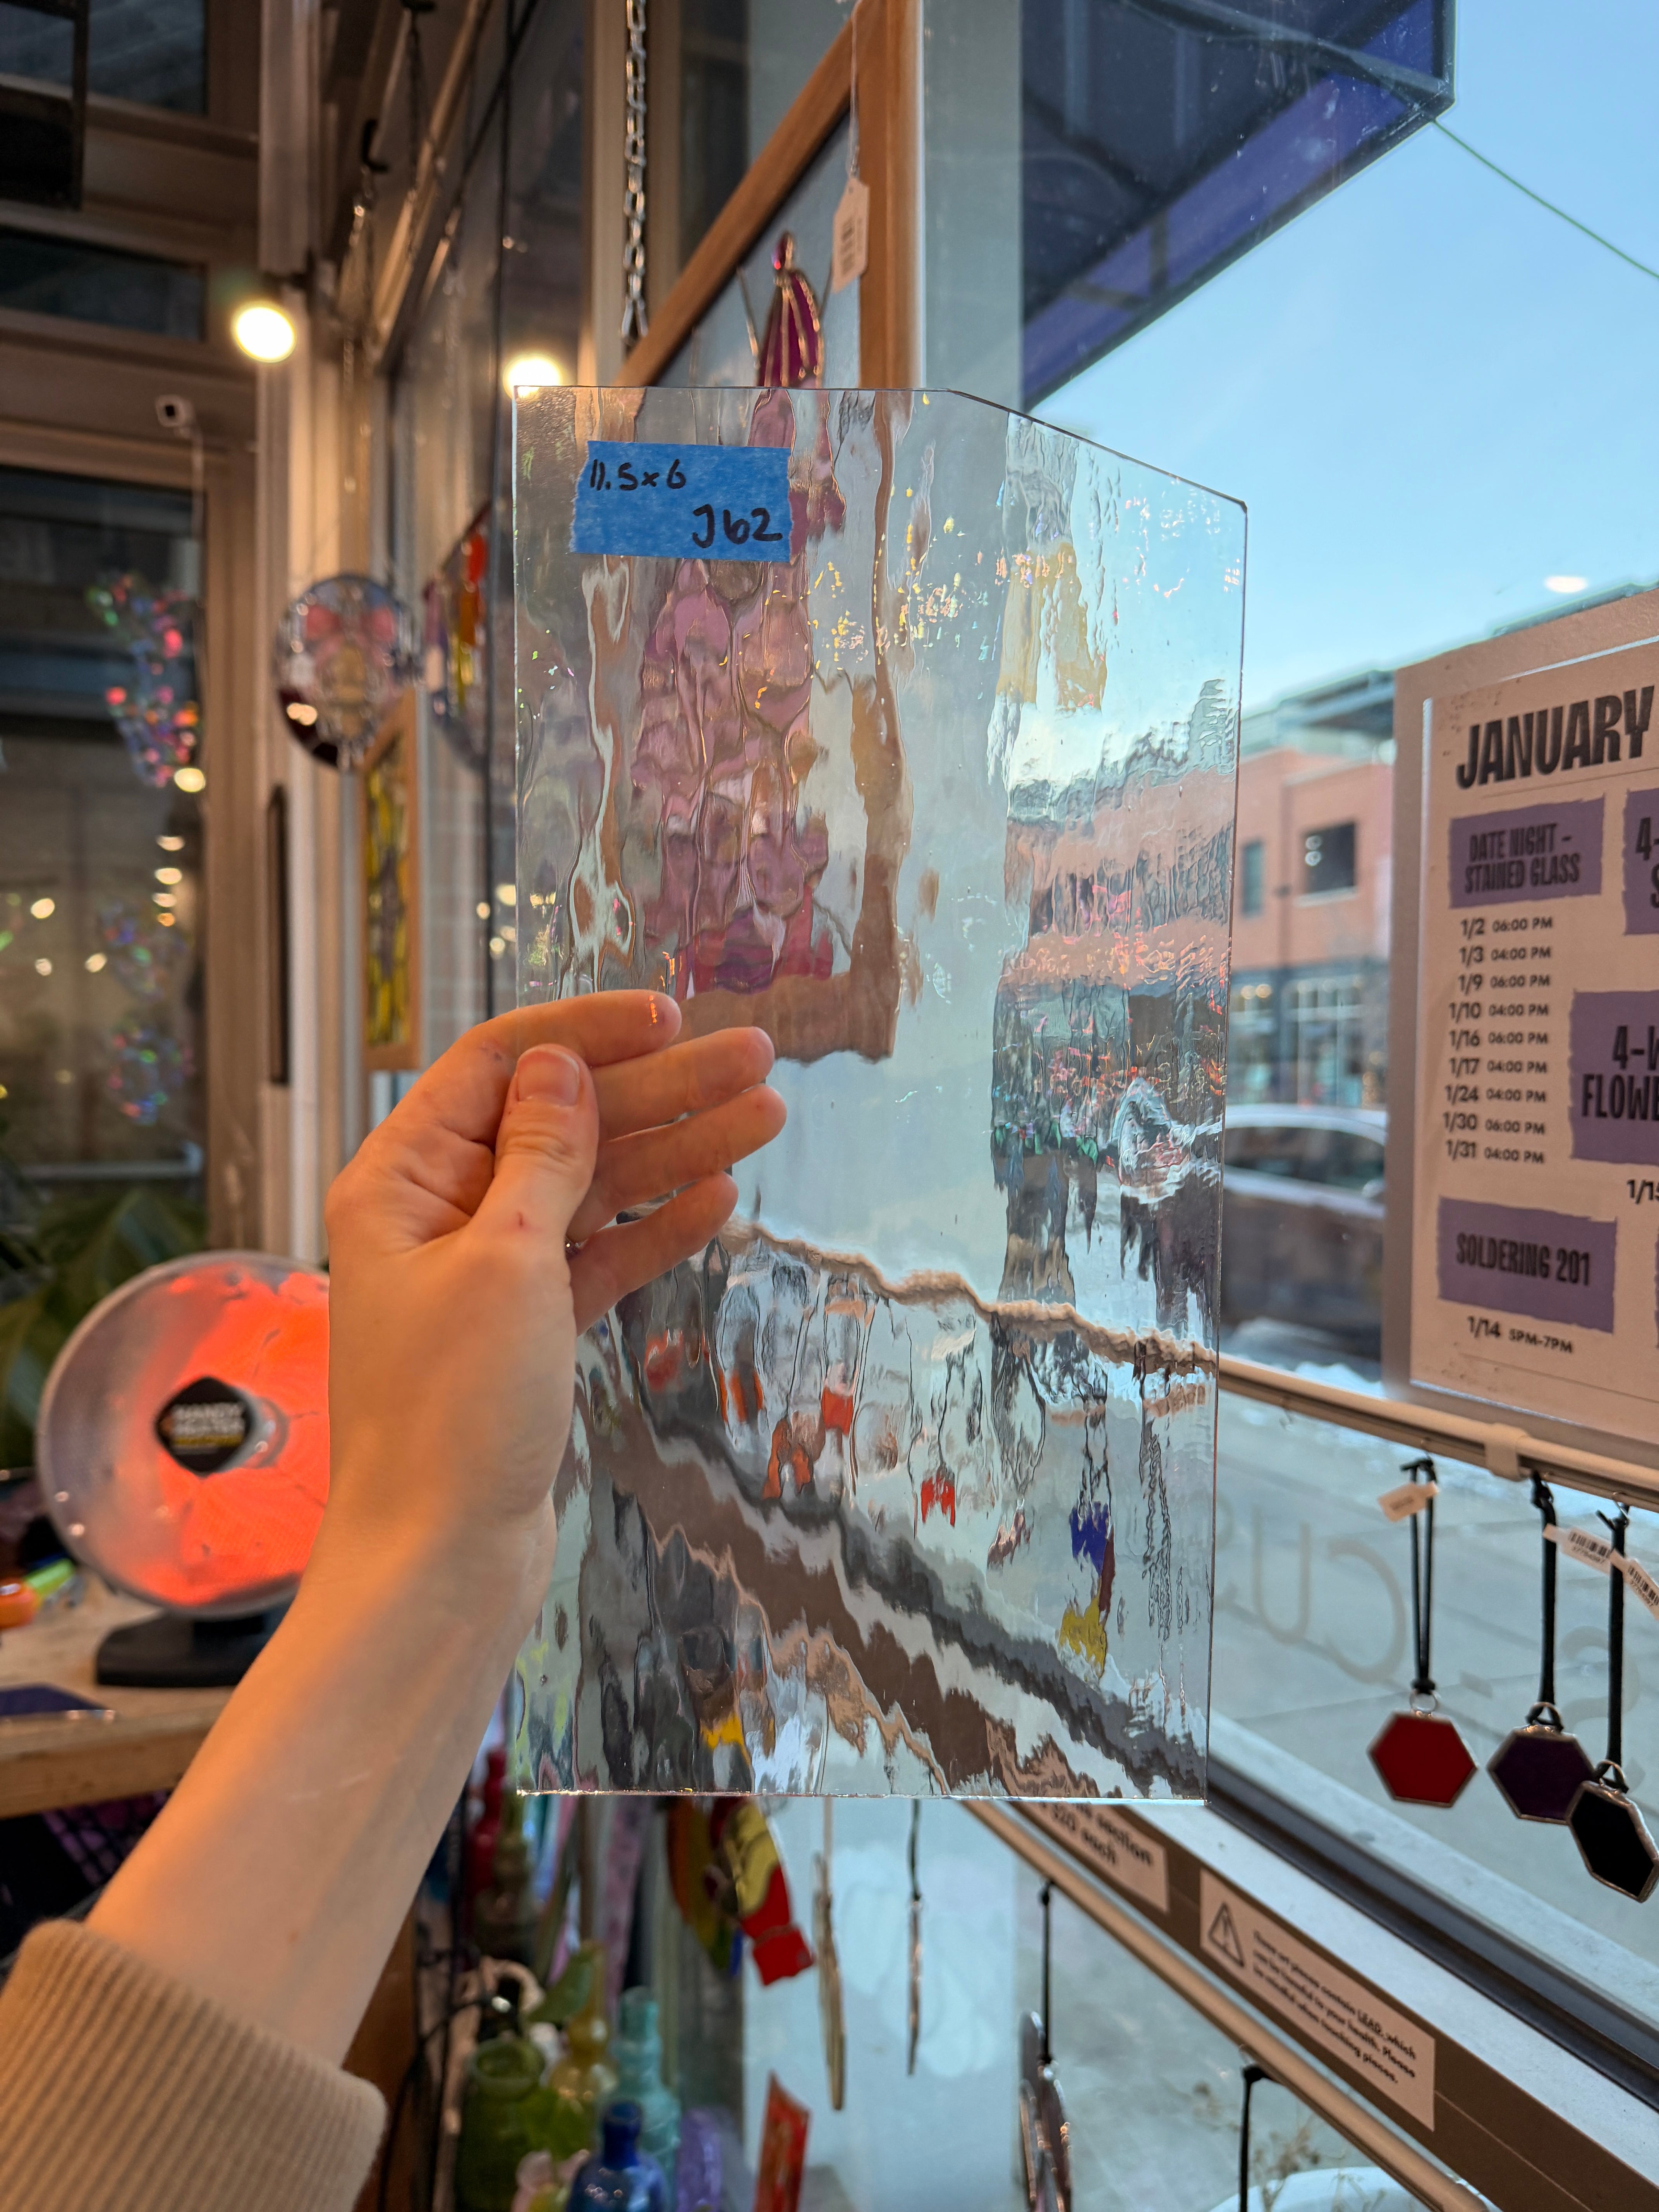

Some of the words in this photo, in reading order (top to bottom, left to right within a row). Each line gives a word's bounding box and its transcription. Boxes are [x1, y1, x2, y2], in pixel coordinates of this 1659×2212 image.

[692, 504, 783, 548] J62
[1456, 685, 1655, 789] JANUARY
[1469, 831, 1505, 862] DATE
[1511, 823, 1558, 857] NIGHT
[1465, 860, 1525, 893] STAINED
[1530, 853, 1580, 887] GLASS
[1461, 918, 1485, 939] 1/2
[1492, 918, 1528, 932] 06:00
[1532, 916, 1553, 929] PM
[1459, 946, 1484, 967] 1/3
[1491, 947, 1526, 960] 04:00
[1531, 947, 1551, 958] PM
[1458, 974, 1482, 995] 1/9
[1491, 976, 1525, 989] 06:00
[1530, 974, 1550, 987] PM
[1449, 1002, 1480, 1023] 1/10
[1489, 1005, 1524, 1017] 04:00
[1529, 1004, 1548, 1016] PM
[1449, 1030, 1480, 1051] 1/16
[1488, 1032, 1523, 1044] 06:00
[1528, 1032, 1548, 1044] PM
[1449, 1058, 1480, 1079] 1/17
[1487, 1061, 1522, 1073] 04:00
[1527, 1061, 1547, 1074] PM
[1445, 1085, 1479, 1105] 1/24
[1486, 1088, 1521, 1102] 04:00
[1526, 1089, 1546, 1103] PM
[1443, 1111, 1477, 1132] 1/30
[1485, 1119, 1520, 1133] 06:00
[1525, 1121, 1545, 1135] PM
[1446, 1139, 1476, 1161] 1/31
[1484, 1149, 1519, 1162] 04:00
[1524, 1150, 1544, 1163] PM
[1456, 1232, 1550, 1278] SOLDERING
[1556, 1247, 1590, 1286] 201
[1468, 1316, 1501, 1338] 1/14
[1508, 1329, 1573, 1353] 5PM-7PM
[1321, 2019, 1360, 2058] touching
[1386, 2033, 1416, 2059] which
[1382, 2046, 1415, 2077] Please
